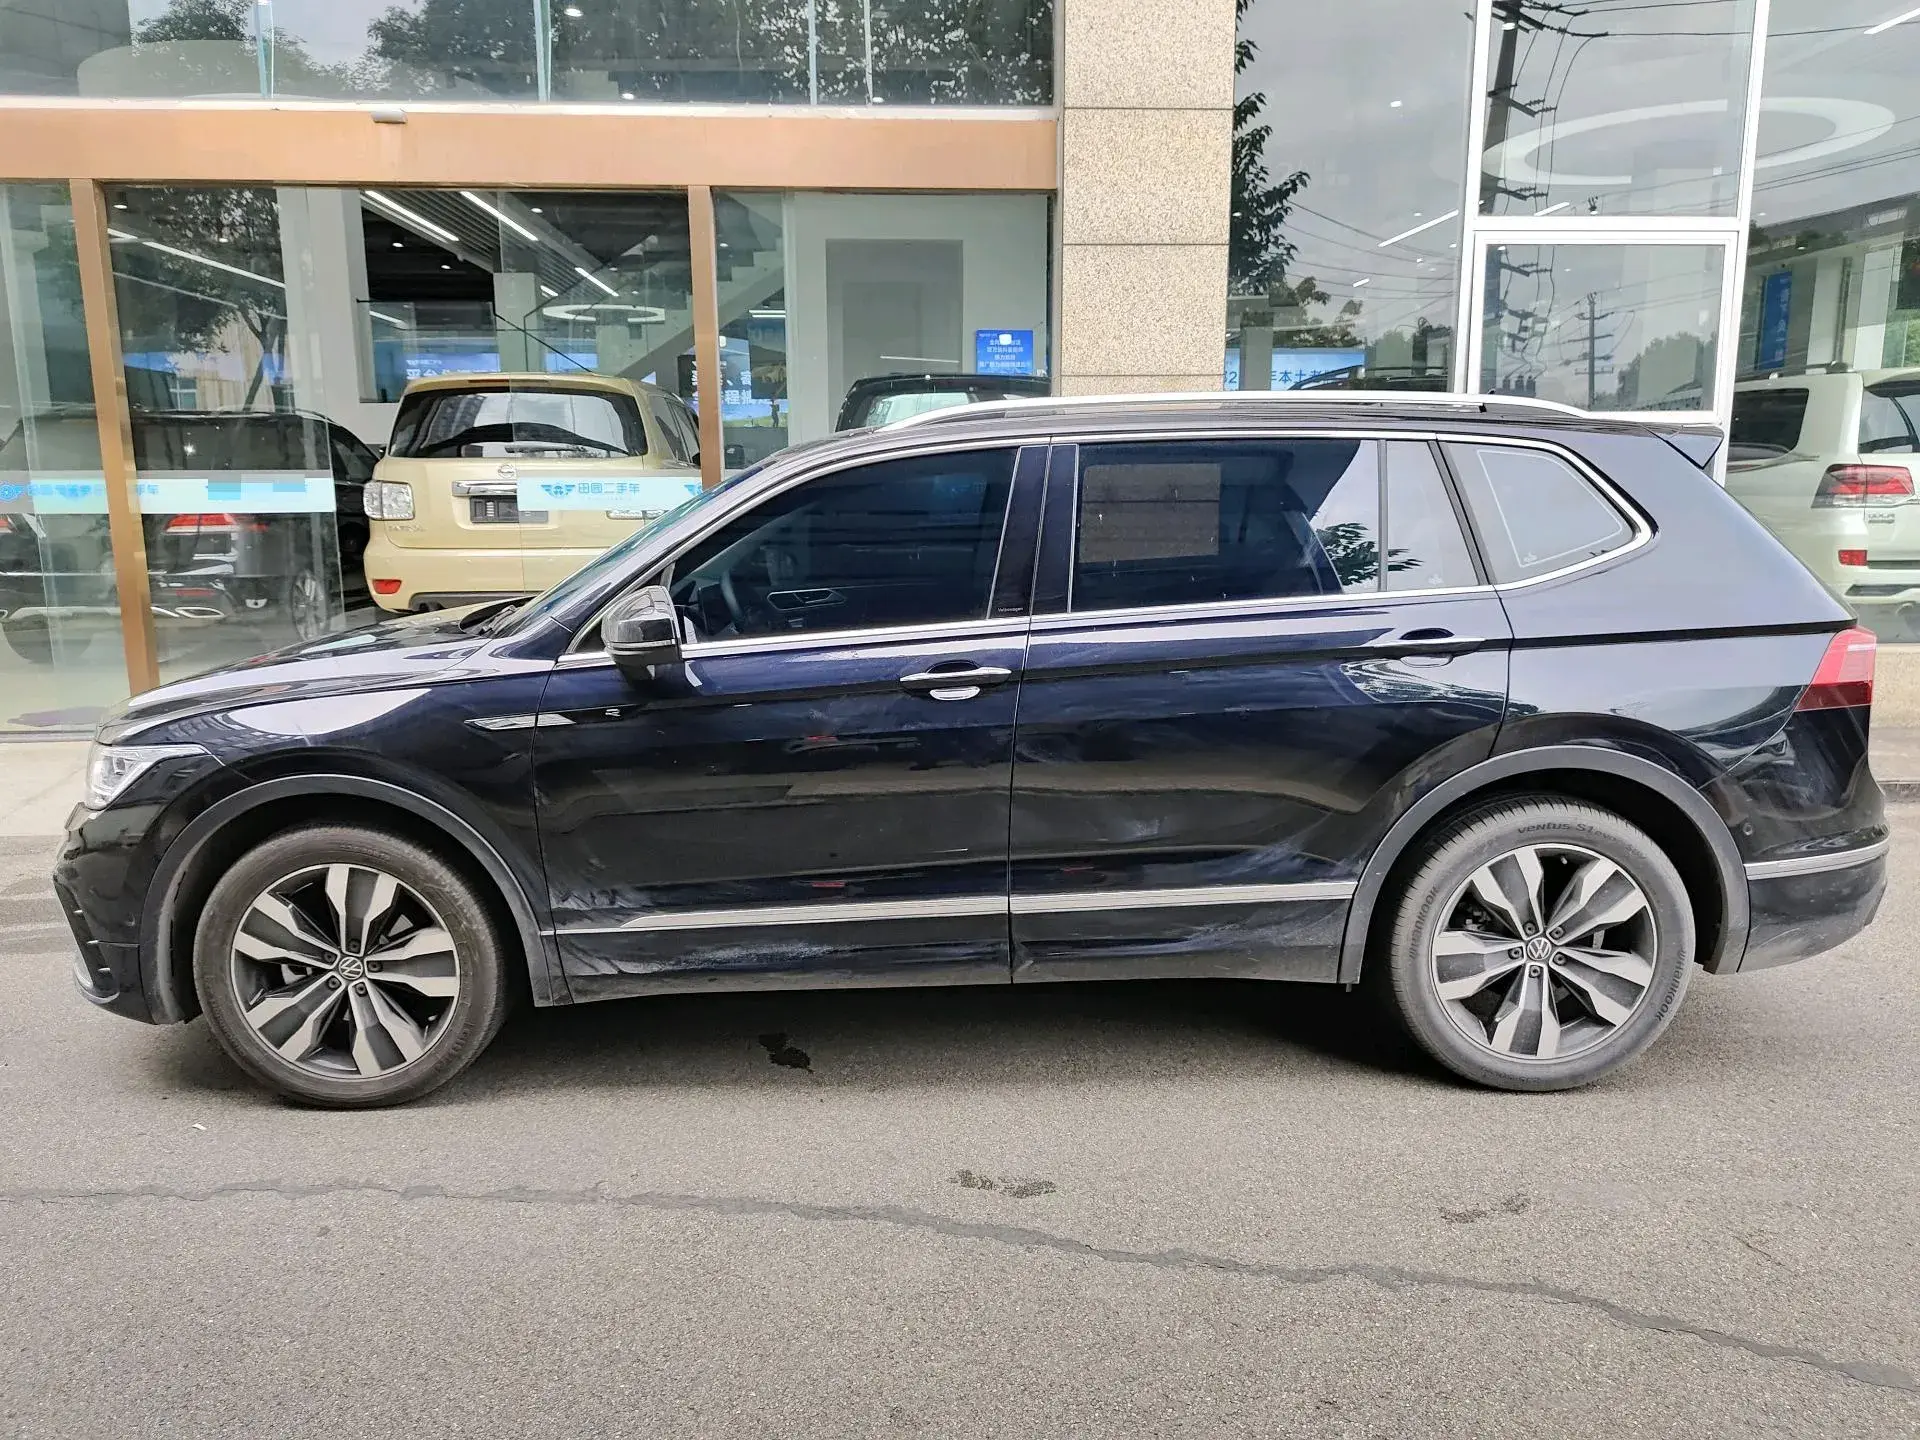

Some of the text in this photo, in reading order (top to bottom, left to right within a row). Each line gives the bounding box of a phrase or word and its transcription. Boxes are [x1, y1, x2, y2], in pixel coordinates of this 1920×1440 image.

[578, 482, 641, 496] 田园二手车
